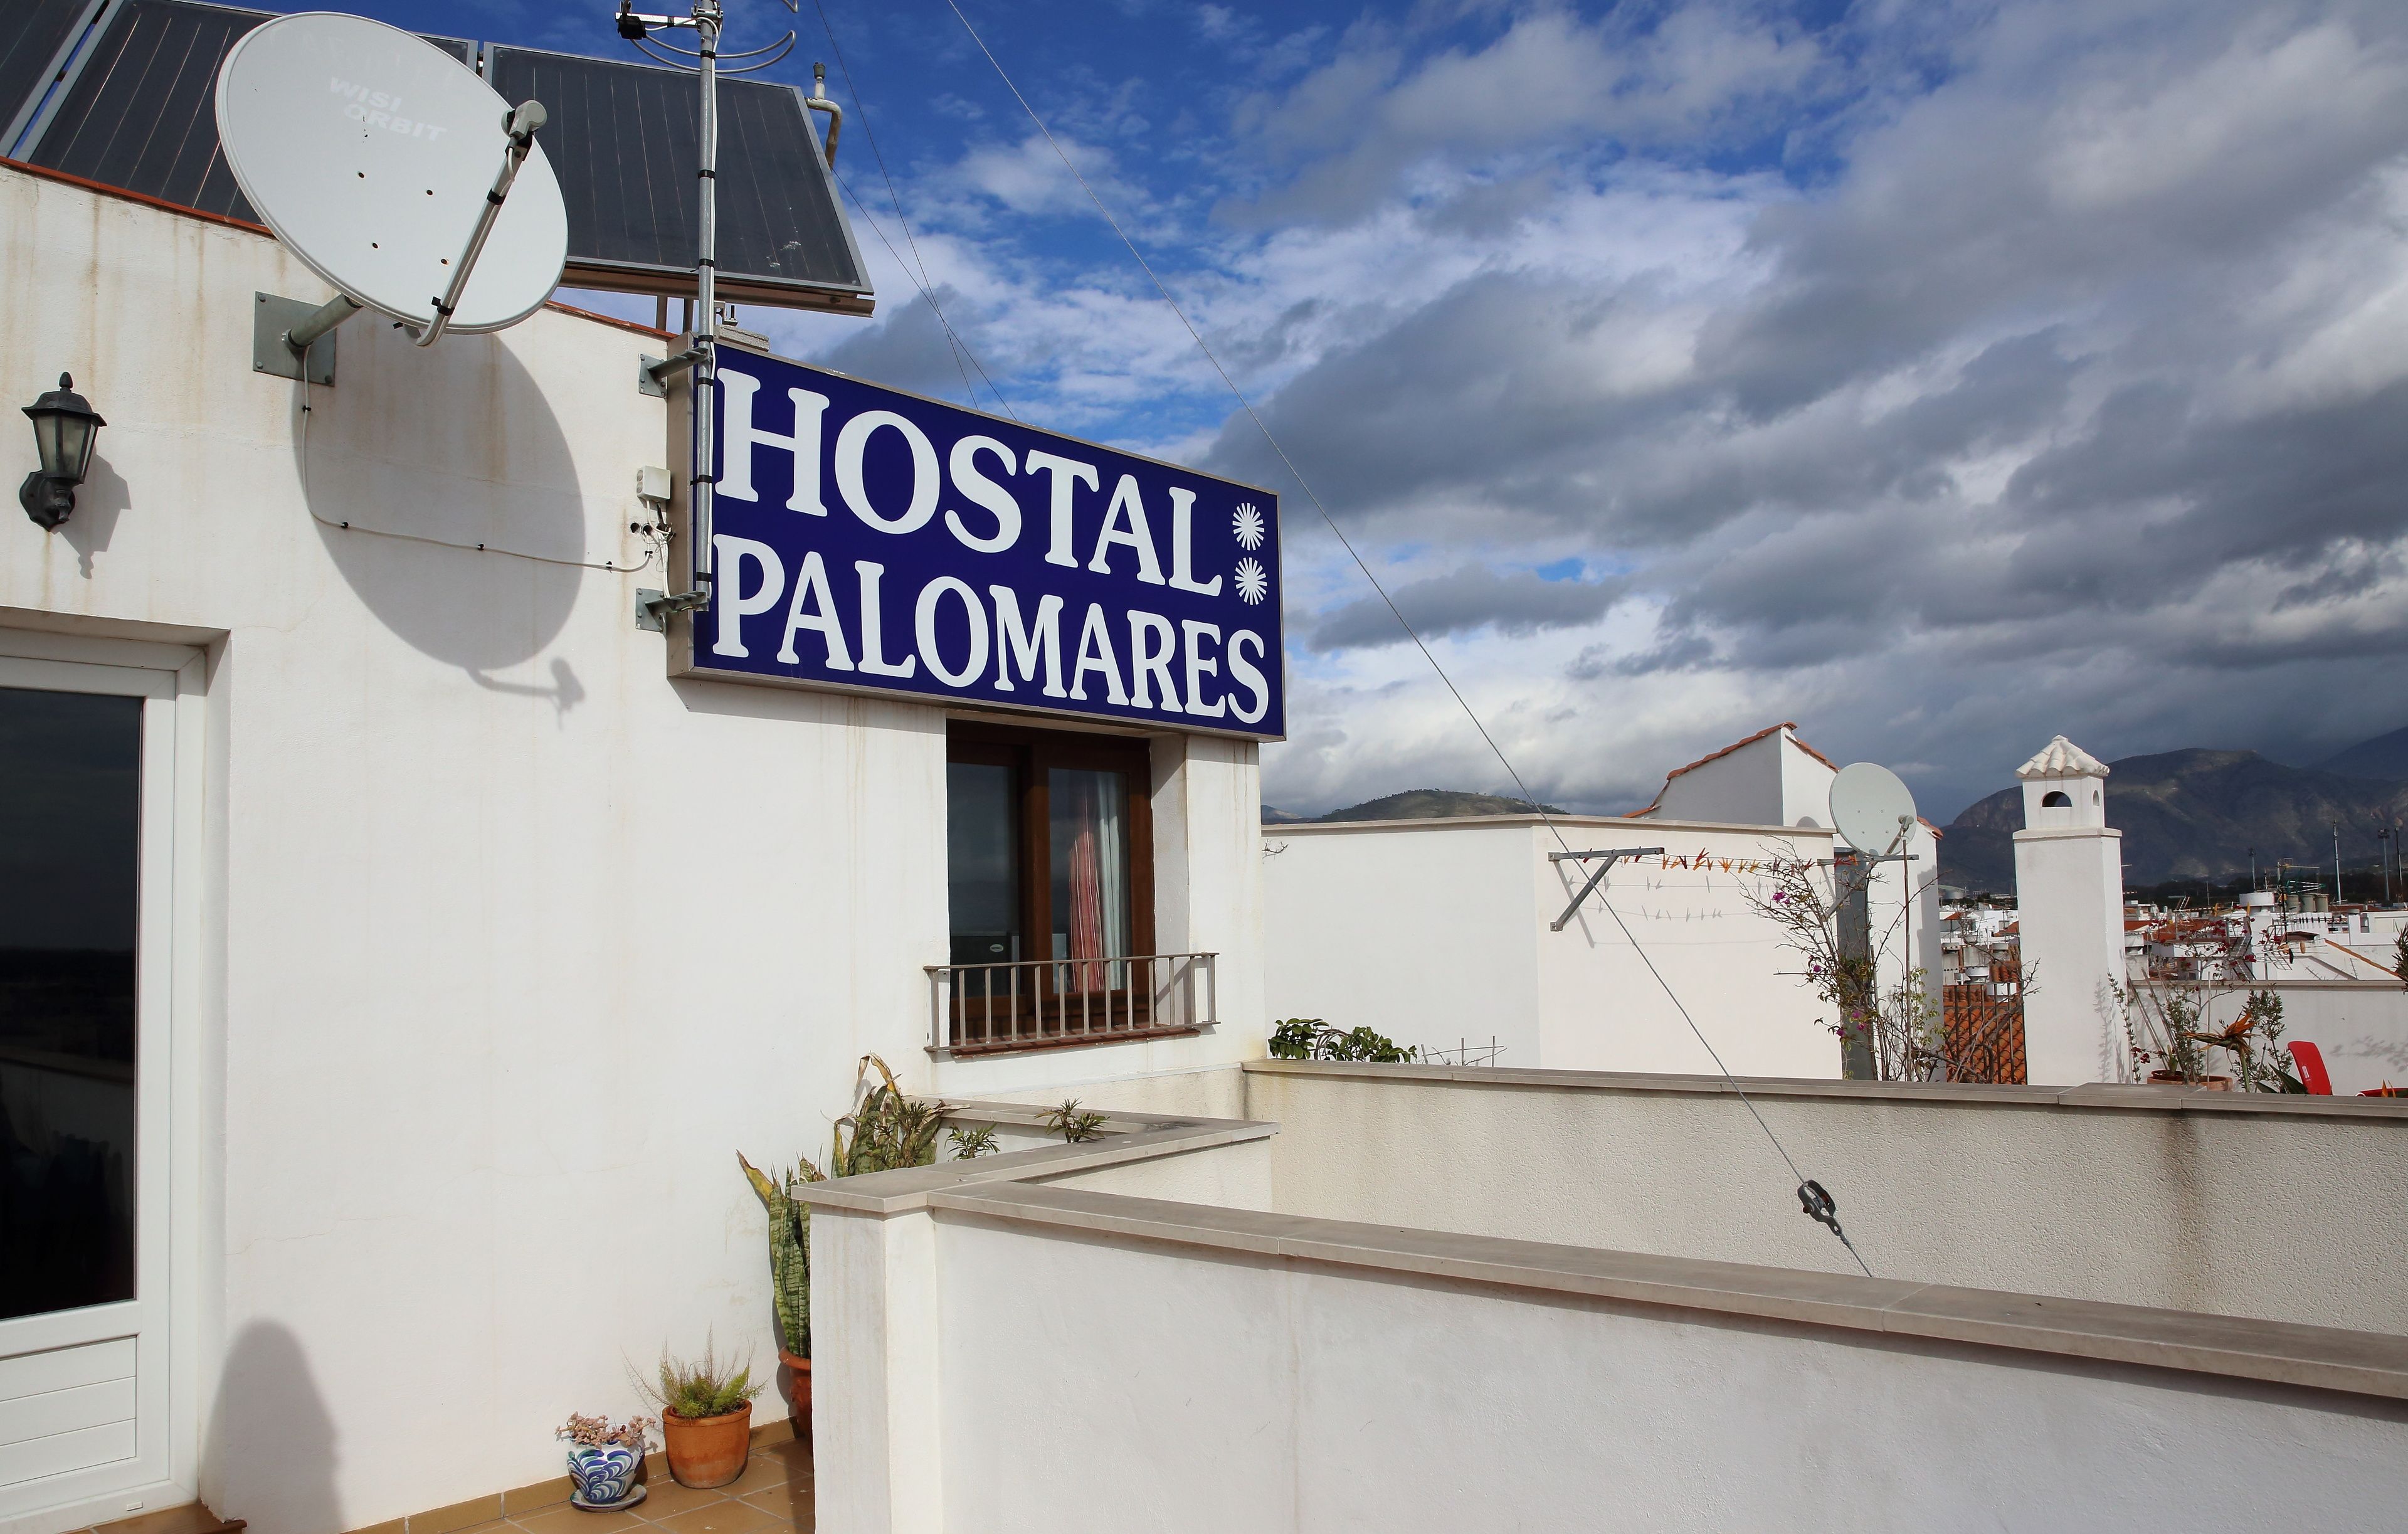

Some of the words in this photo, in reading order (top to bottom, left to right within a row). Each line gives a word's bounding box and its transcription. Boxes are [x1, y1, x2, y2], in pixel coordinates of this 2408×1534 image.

[330, 77, 402, 113] WISI
[344, 104, 447, 142] ORBIT
[715, 368, 1223, 596] HOSTAL
[712, 534, 1269, 724] PALOMARES
